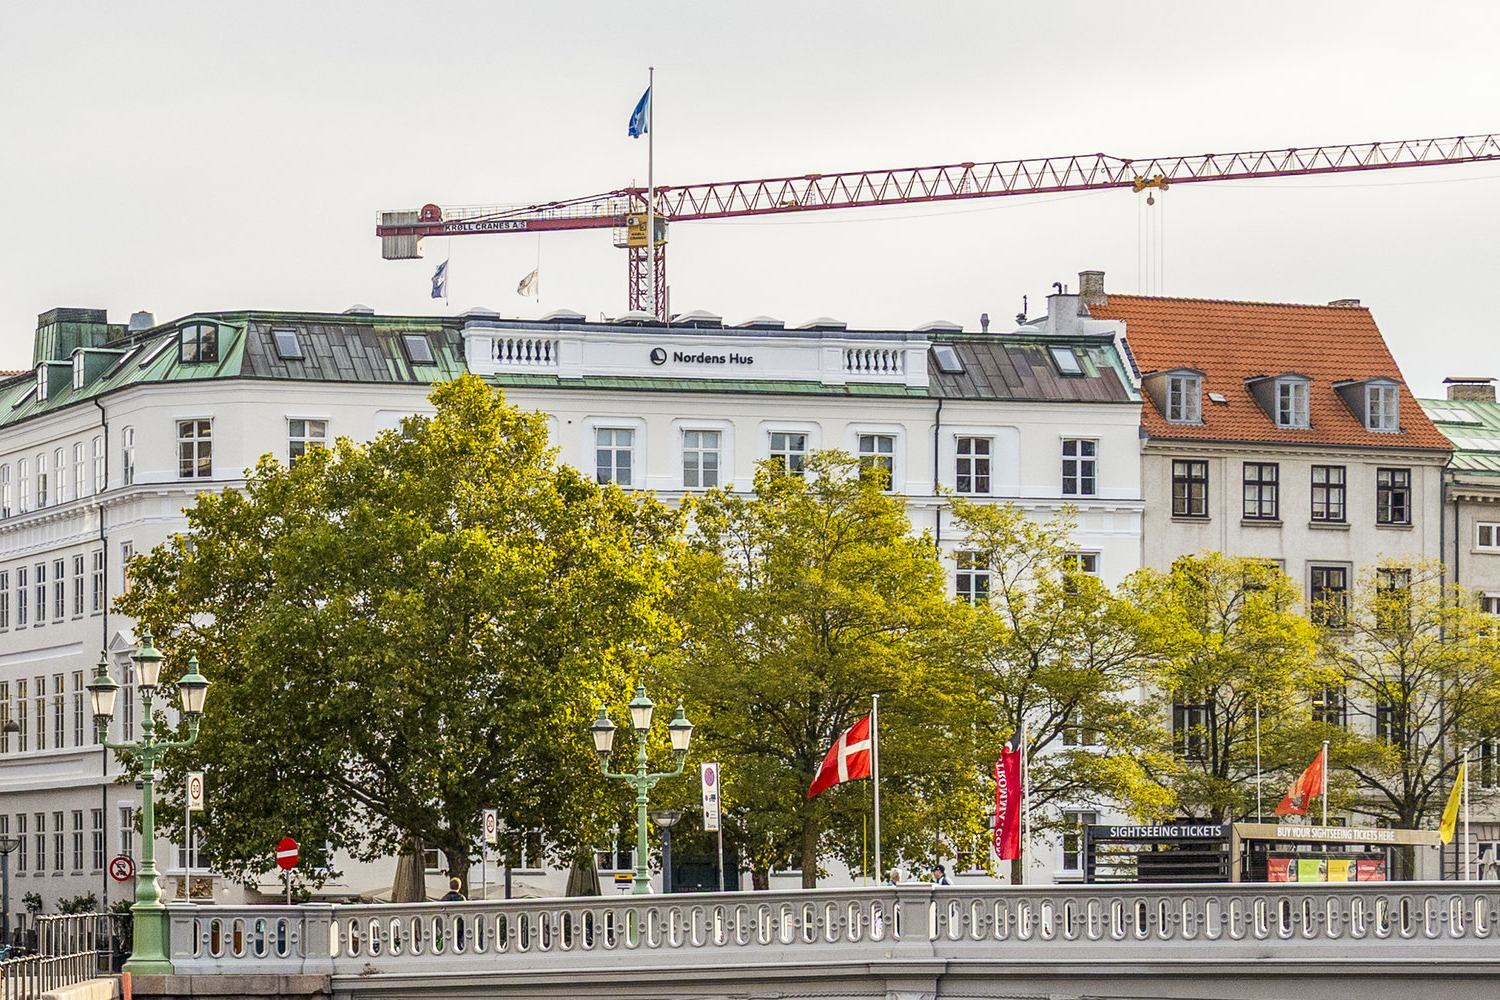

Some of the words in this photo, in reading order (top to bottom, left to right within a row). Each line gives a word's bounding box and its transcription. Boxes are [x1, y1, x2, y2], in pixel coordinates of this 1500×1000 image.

[475, 222, 510, 231] CRANES
[673, 352, 726, 364] Nordens
[729, 353, 754, 365] Hus
[1110, 826, 1178, 838] SIGHTSEEING
[1180, 825, 1222, 837] TICKETS
[1277, 827, 1291, 838] BUY
[1291, 827, 1311, 839] YOUR
[1311, 828, 1353, 840] SIGHTSEEING
[1353, 829, 1378, 841] TICKETS
[1378, 830, 1395, 842] HERE
